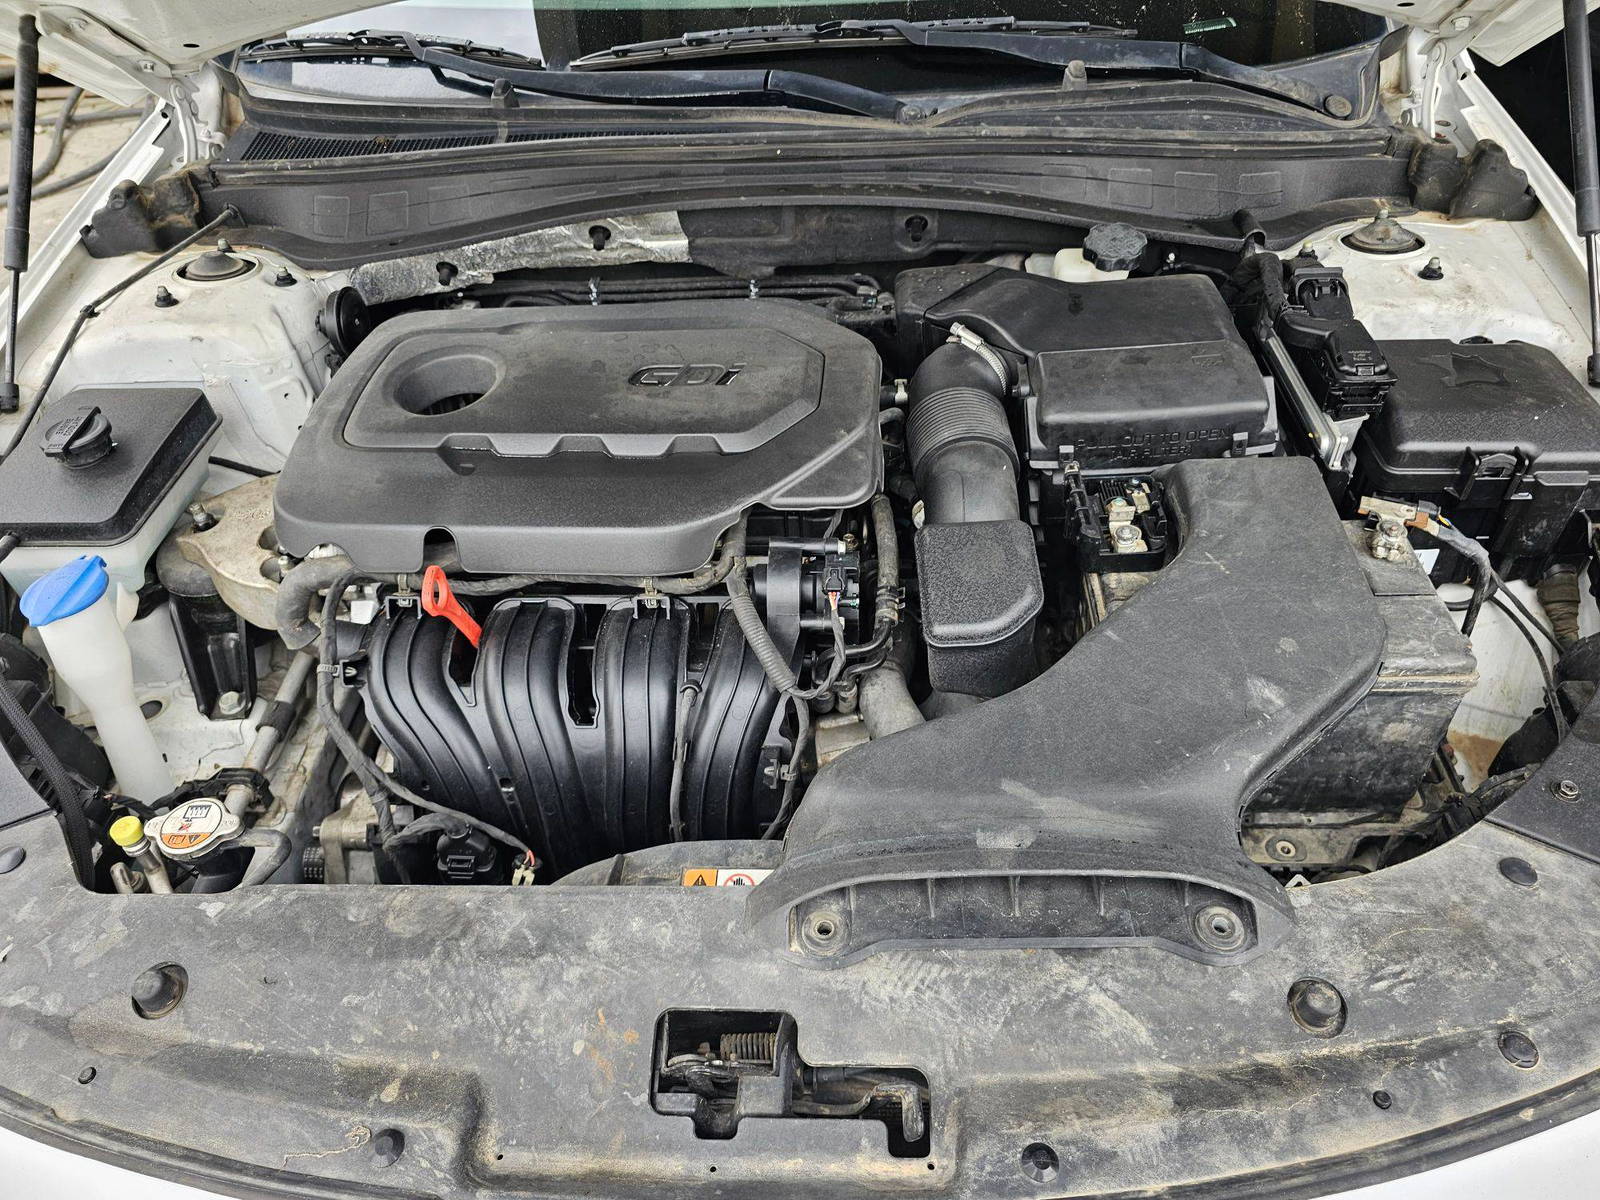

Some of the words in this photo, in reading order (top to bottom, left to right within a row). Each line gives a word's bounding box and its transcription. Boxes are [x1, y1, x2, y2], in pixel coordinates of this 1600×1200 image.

[1121, 433, 1156, 447] OUT
[1159, 431, 1181, 445] TO
[1185, 428, 1232, 443] OPEN
